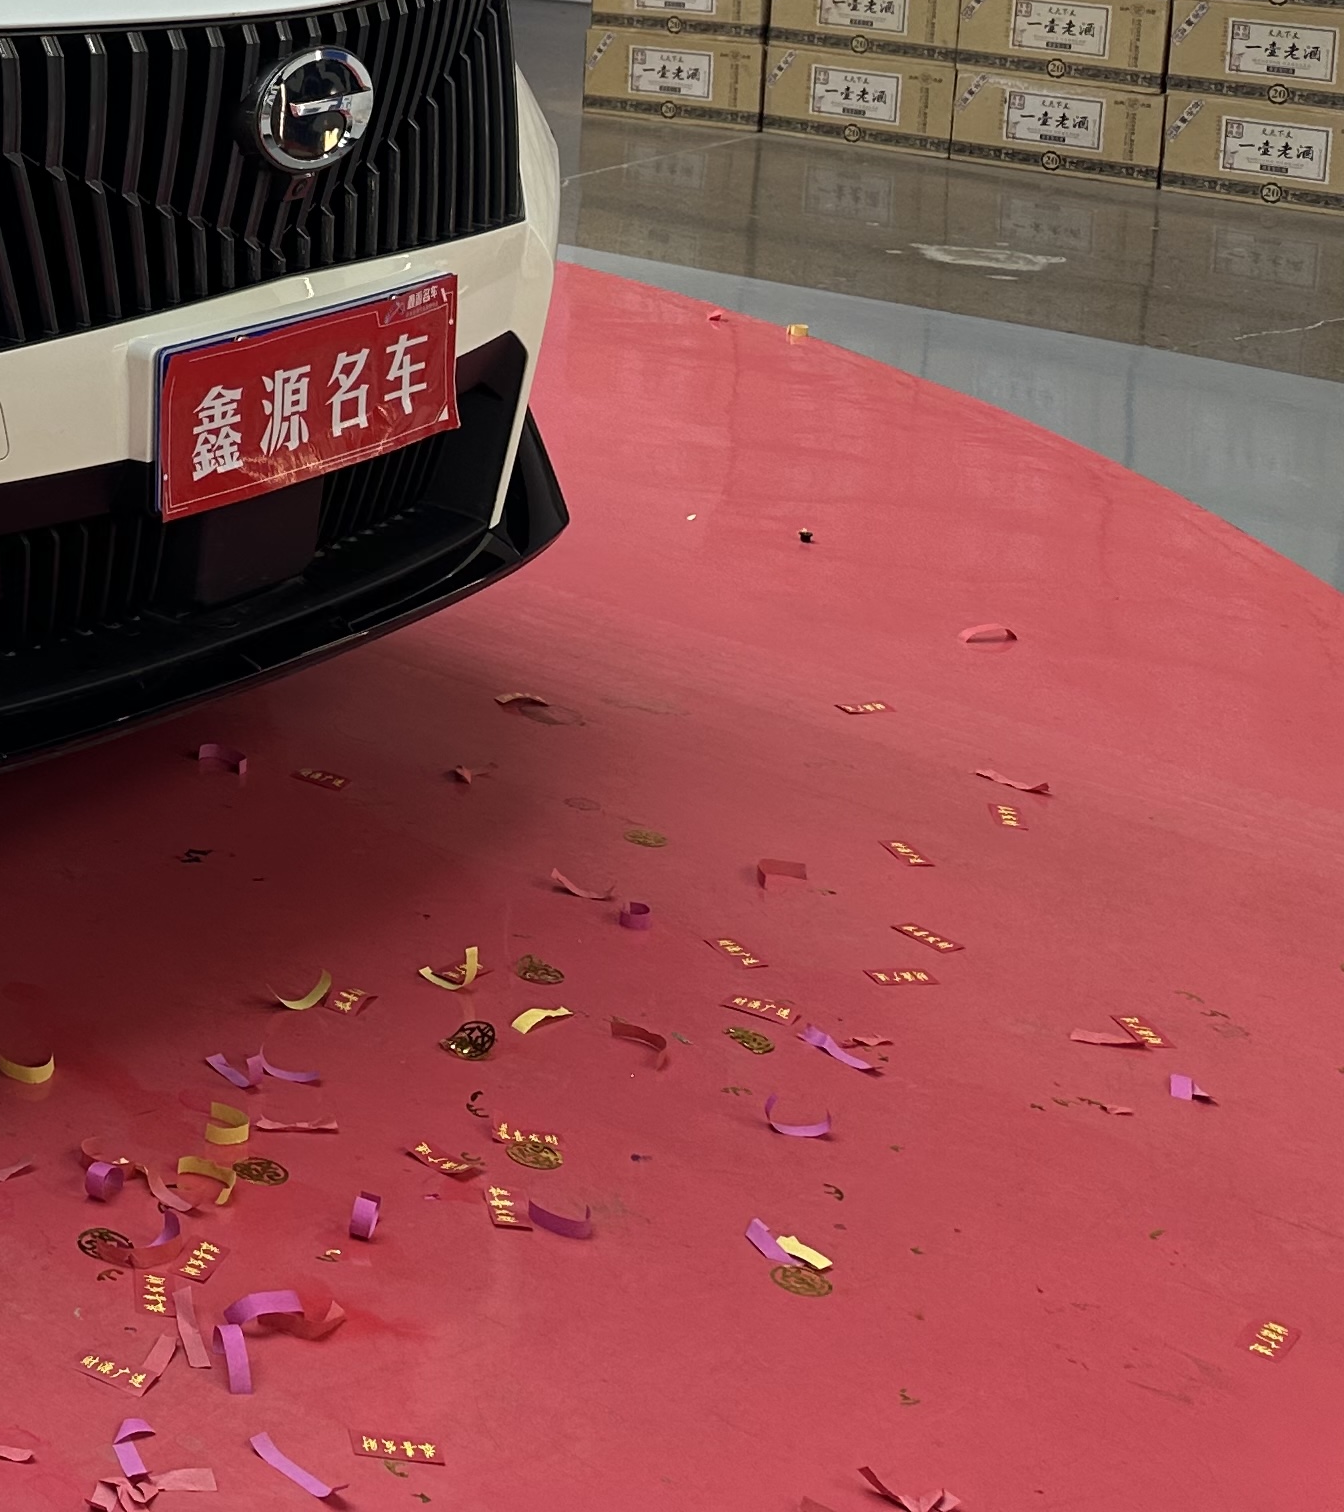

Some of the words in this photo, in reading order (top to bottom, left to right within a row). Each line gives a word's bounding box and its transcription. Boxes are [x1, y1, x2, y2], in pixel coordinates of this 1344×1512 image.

[1050, 63, 1064, 73] 20
[1271, 89, 1285, 99] 20
[1044, 155, 1058, 165] 20
[1264, 187, 1279, 197] 20
[192, 333, 429, 482] 鑫源名车
[732, 997, 790, 1019] 财源广进
[80, 1354, 146, 1388] 财源广进
